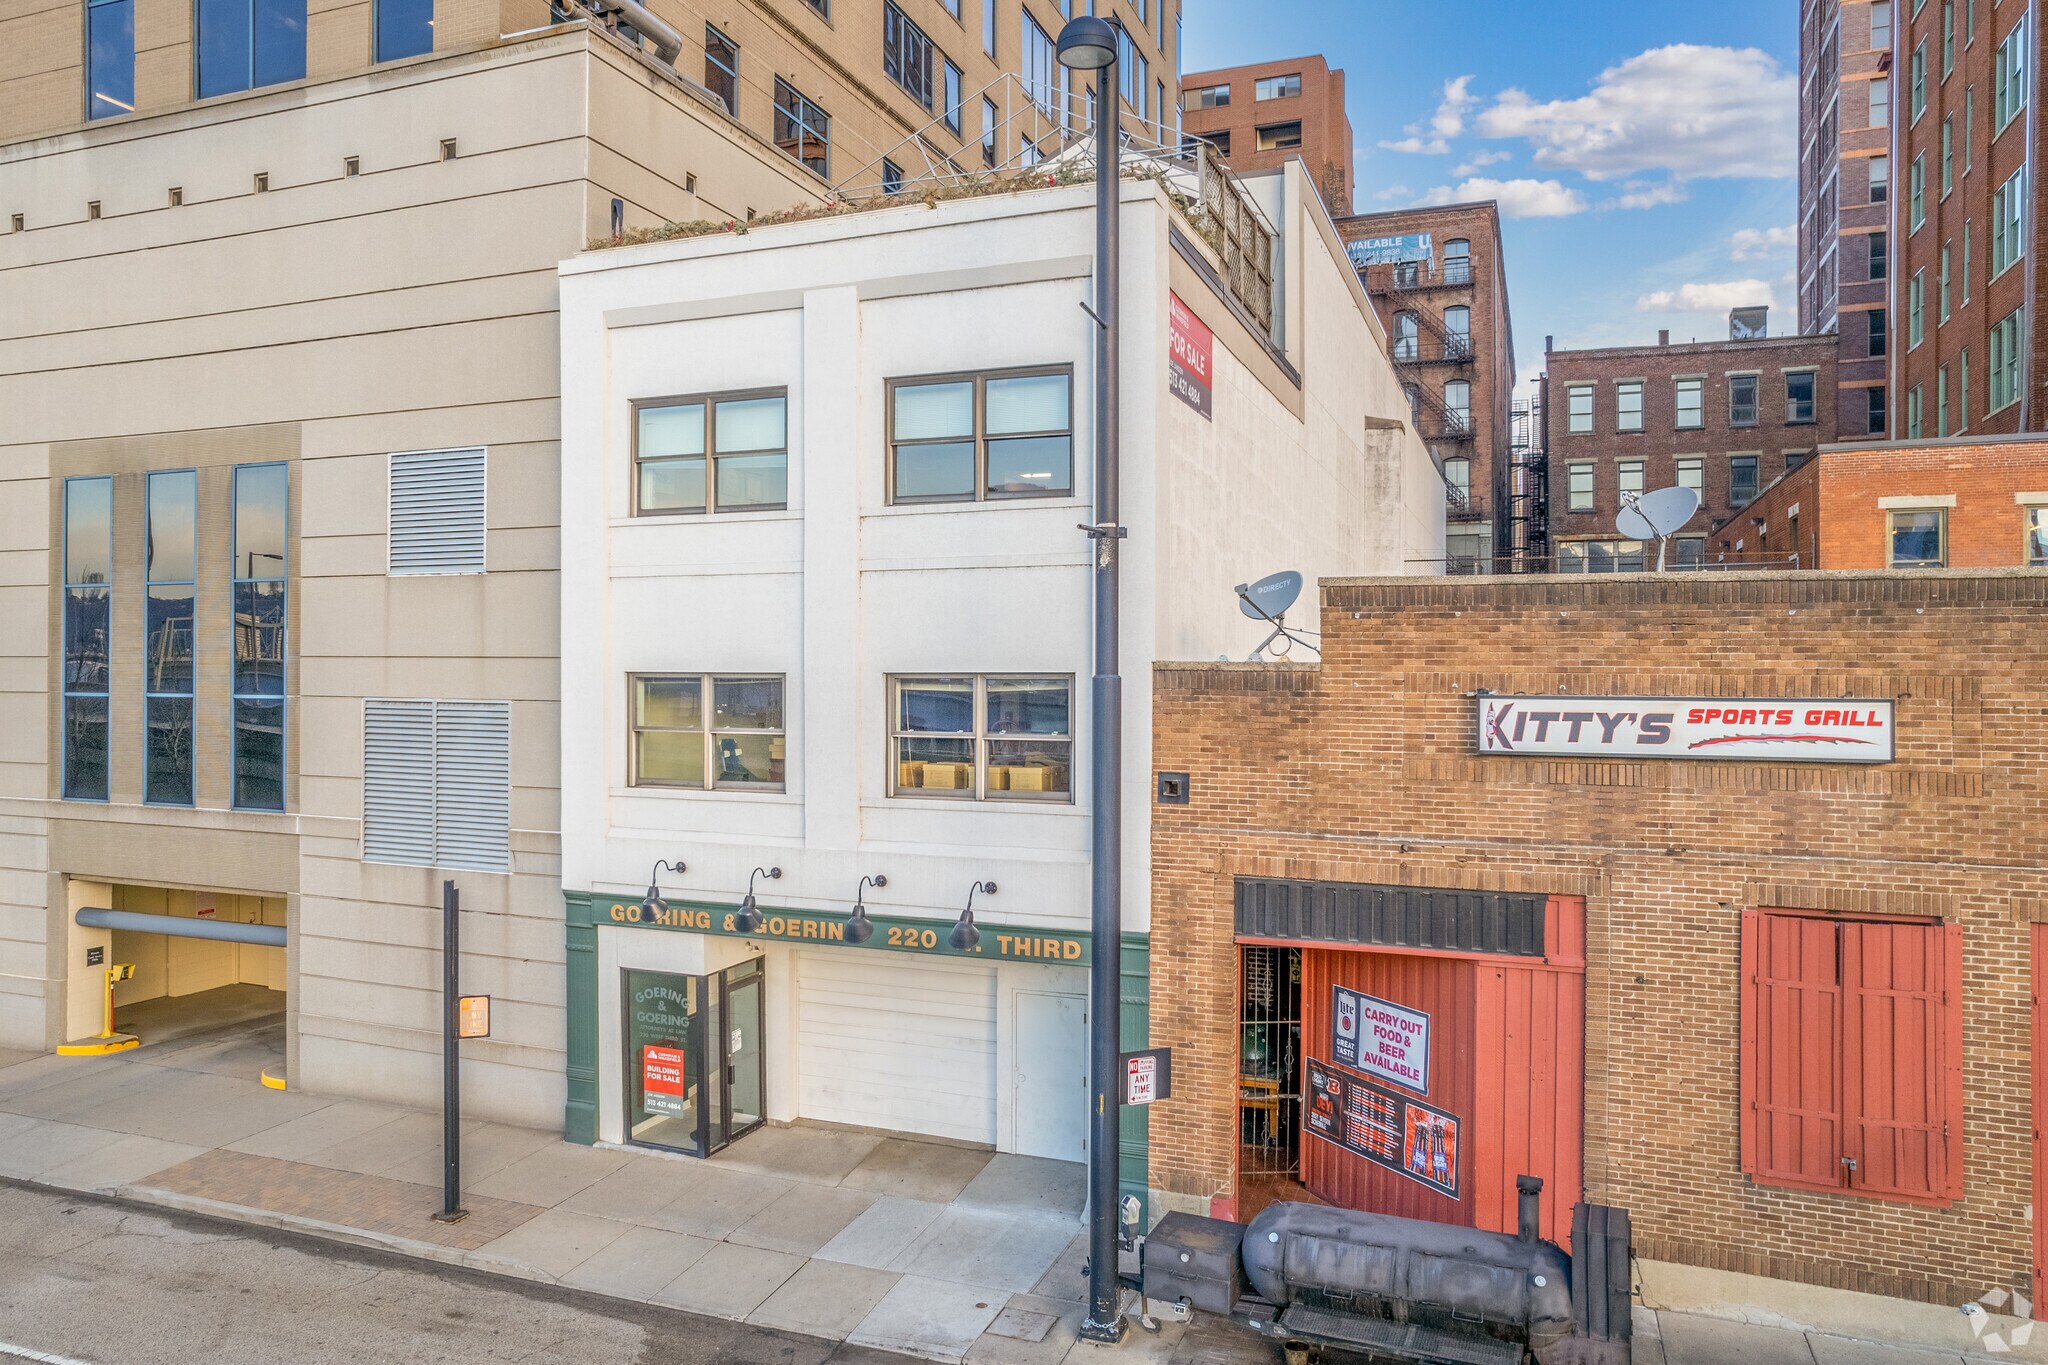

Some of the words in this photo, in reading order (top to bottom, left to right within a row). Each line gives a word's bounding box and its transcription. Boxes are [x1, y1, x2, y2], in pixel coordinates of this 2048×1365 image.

[1170, 327, 1185, 359] FOR
[1187, 343, 1205, 376] SALE
[1263, 579, 1291, 593] DIRECTV
[1486, 702, 1674, 750] KITTY'S
[1687, 709, 1793, 725] SPORTS
[1804, 709, 1883, 726] GRILL
[610, 904, 711, 929] GORING
[887, 927, 937, 948] 220
[997, 935, 1081, 960] THIRD
[635, 987, 690, 1009] GOERING
[658, 1000, 667, 1011] &
[1340, 1001, 1354, 1015] Lite
[637, 1012, 690, 1028] GOERING
[1365, 1007, 1399, 1027] CARRY
[1400, 1019, 1422, 1035] OUT
[1374, 1025, 1402, 1043] FOOD
[1404, 1036, 1411, 1047] &
[1336, 1038, 1355, 1050] GREAT
[1379, 1042, 1405, 1060] BEER
[1336, 1046, 1354, 1058] TASTE
[647, 1065, 680, 1076] BUILDING
[1130, 1062, 1138, 1071] NO
[1364, 1052, 1419, 1081] AVAILABLE
[647, 1072, 662, 1080] FOR
[663, 1075, 681, 1083] SALE
[1135, 1074, 1149, 1083] ANY
[1134, 1084, 1150, 1094] TIME
[657, 1100, 666, 1108] 421
[667, 1102, 681, 1110] 4884
